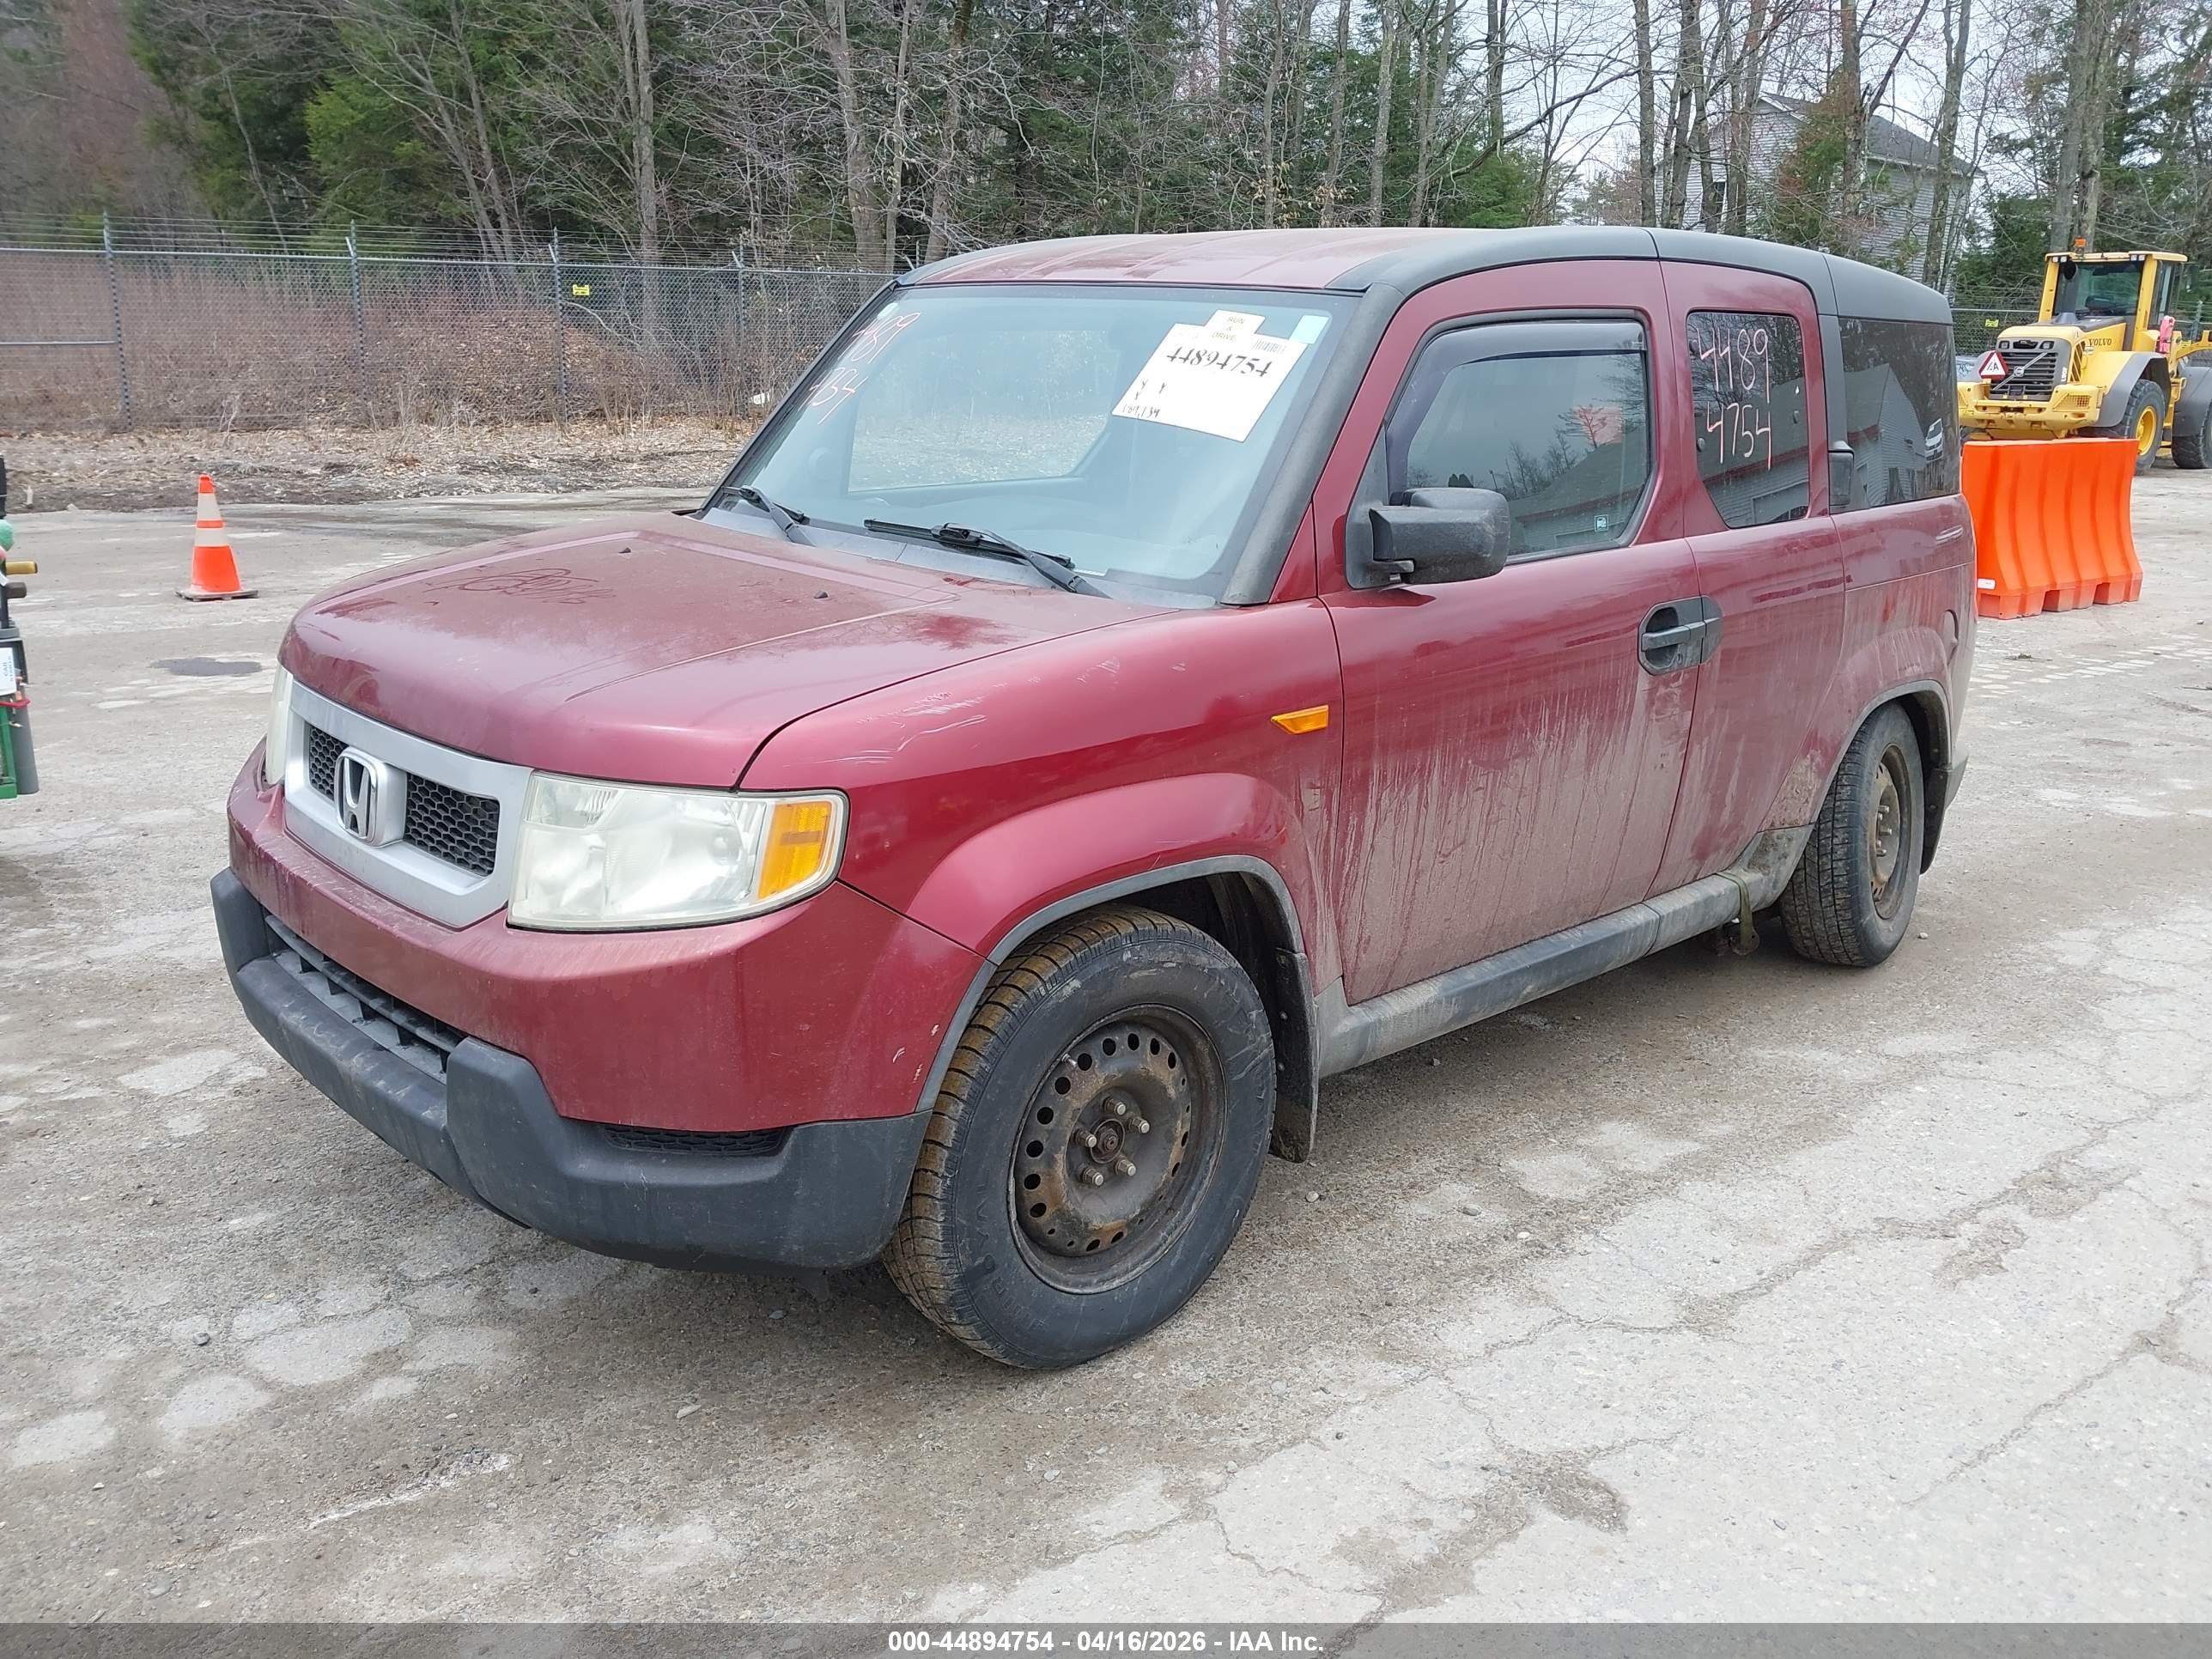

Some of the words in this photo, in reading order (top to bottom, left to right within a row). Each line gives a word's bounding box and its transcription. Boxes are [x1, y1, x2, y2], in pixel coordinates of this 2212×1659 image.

[1211, 331, 1237, 341] DRIVE
[2088, 338, 2112, 347] VOLVO
[1166, 346, 1273, 377] 44894754
[1697, 328, 1771, 404] 4489
[1706, 401, 1772, 471] 4754
